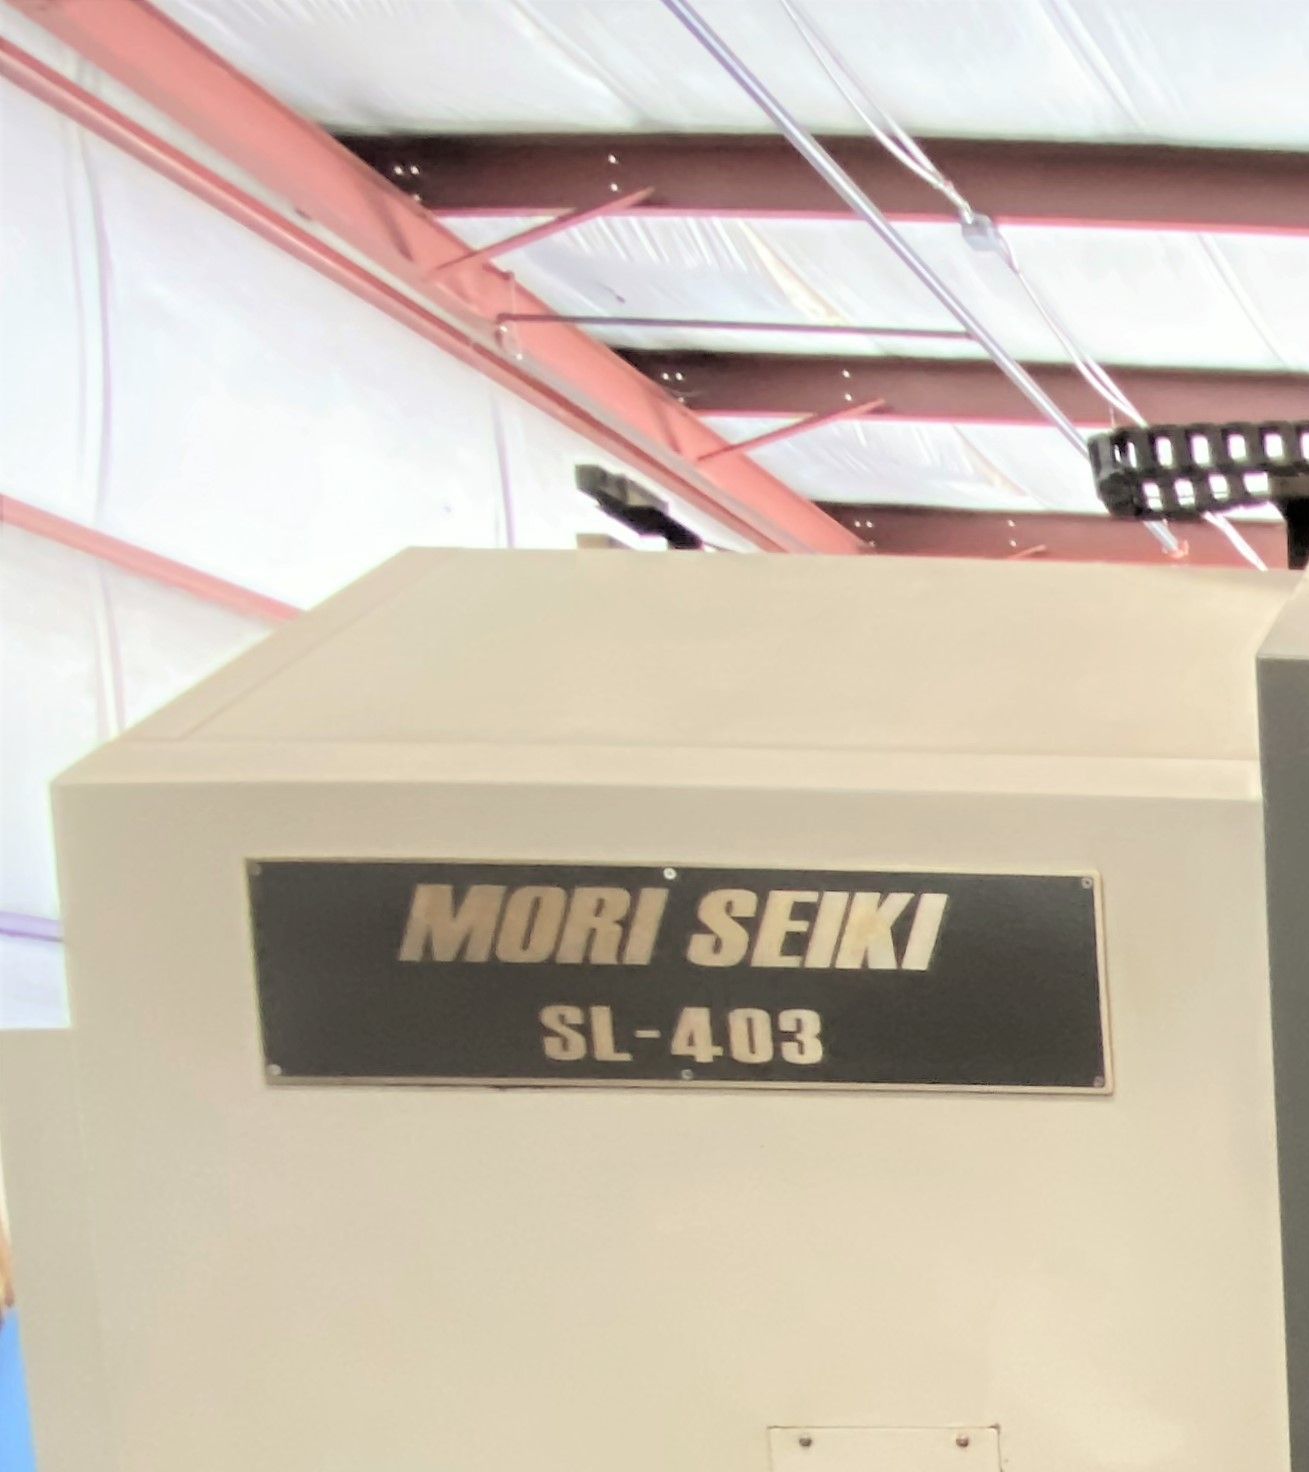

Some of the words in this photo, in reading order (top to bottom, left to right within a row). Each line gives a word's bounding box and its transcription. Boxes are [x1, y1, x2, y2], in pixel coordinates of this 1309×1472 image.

[399, 884, 669, 965] MORI
[686, 888, 949, 971] SEIKI
[538, 1004, 825, 1065] SL-403
